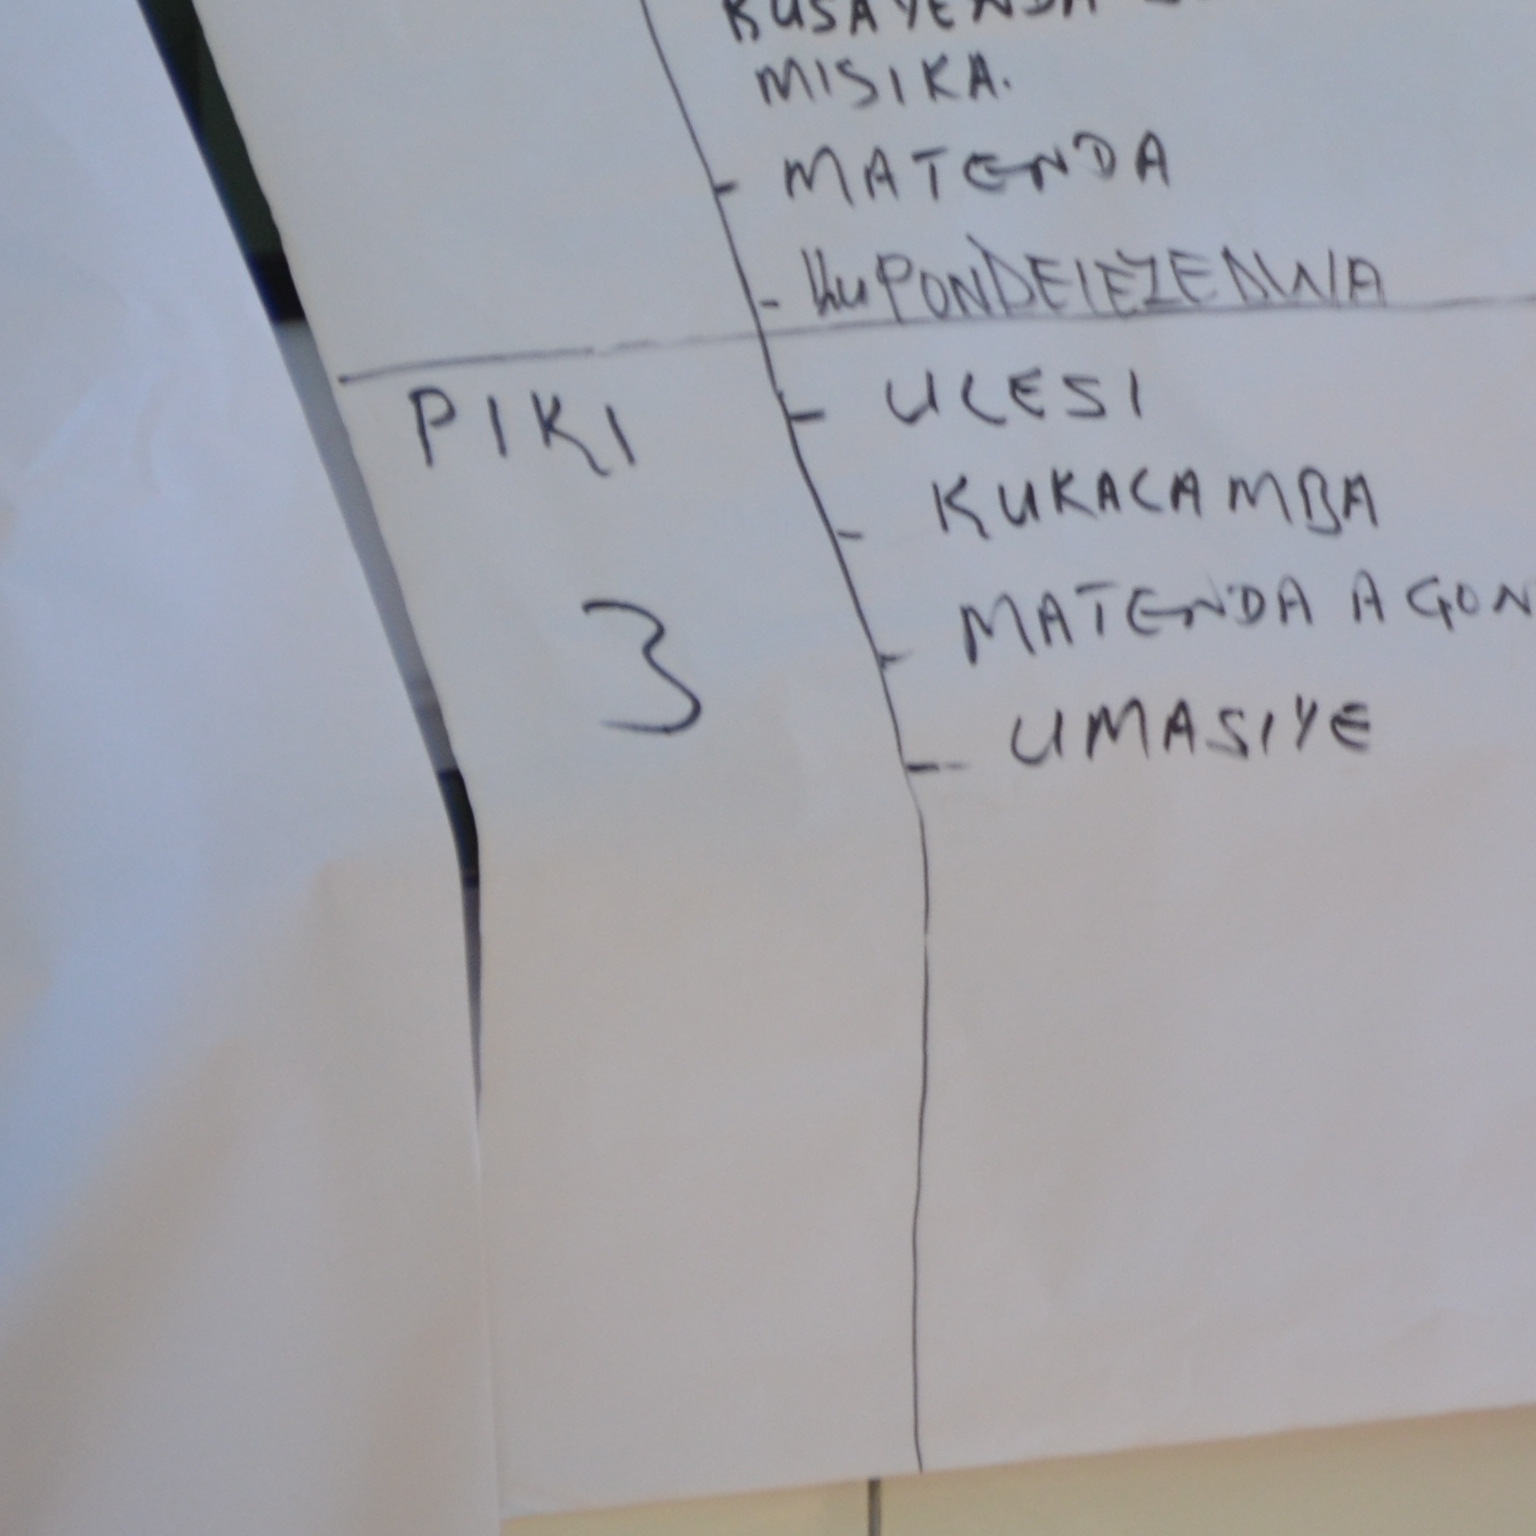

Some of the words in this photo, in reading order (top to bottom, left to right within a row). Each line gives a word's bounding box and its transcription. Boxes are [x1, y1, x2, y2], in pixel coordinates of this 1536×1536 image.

[784, 129, 1170, 208] MATENDA
[407, 385, 637, 479] PIKI
[885, 367, 1143, 426] ULESI
[960, 578, 1314, 666] MATENDA
[581, 599, 703, 736] 3
